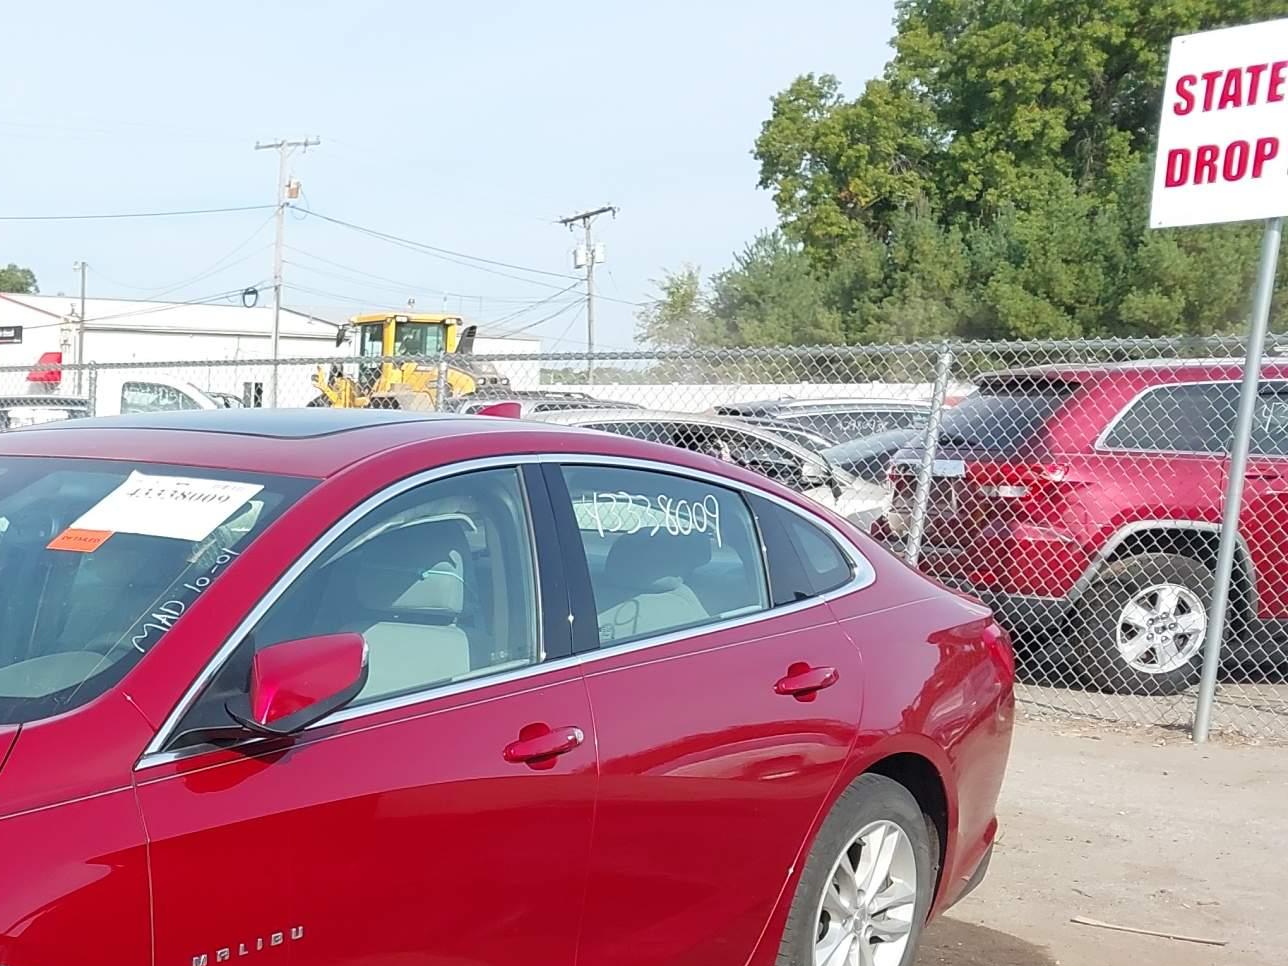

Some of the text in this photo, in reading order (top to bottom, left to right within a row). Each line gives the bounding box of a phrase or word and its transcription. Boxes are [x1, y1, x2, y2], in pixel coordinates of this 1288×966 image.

[1173, 60, 1288, 116] STATE
[1165, 136, 1280, 188] DROP
[127, 487, 231, 504] 43338009
[582, 492, 722, 547] 43338009
[132, 600, 186, 653] MAD
[184, 547, 241, 593] 10-01
